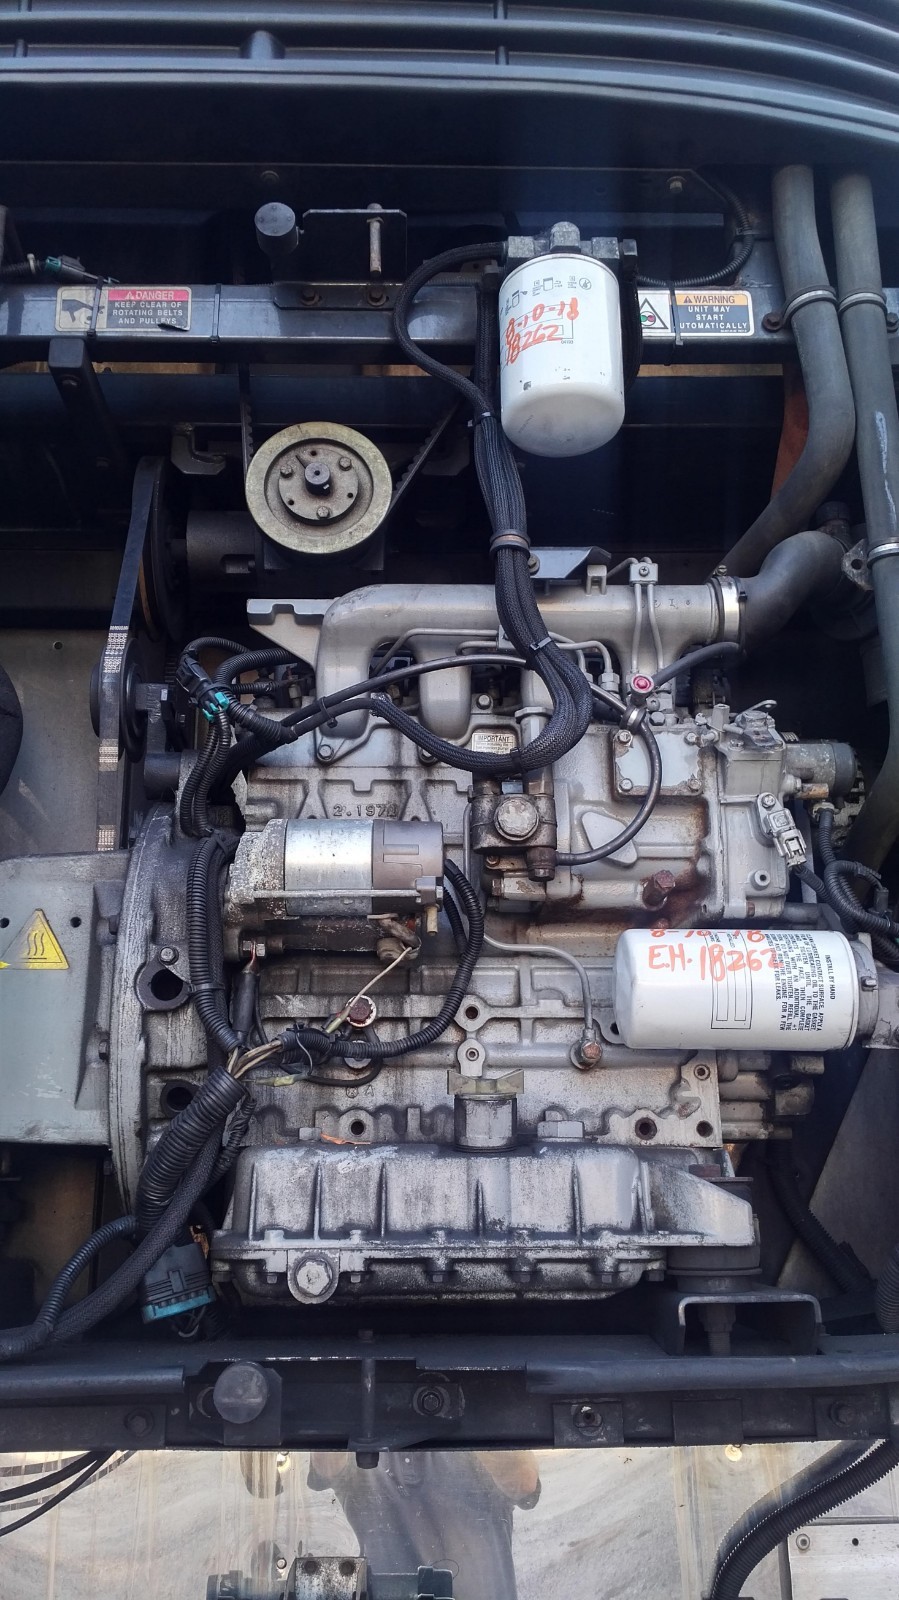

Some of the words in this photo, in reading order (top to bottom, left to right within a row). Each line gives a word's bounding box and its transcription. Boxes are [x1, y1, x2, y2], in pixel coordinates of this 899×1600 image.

[136, 291, 174, 300] DANGER
[694, 295, 735, 304] WARNING
[478, 734, 510, 742] IMPORTANT
[700, 944, 783, 982] 18262
[800, 947, 808, 964] TIGHTEN
[815, 960, 823, 983] CONTACT
[825, 955, 833, 974] INSTALL
[810, 1013, 818, 1031] GASKET.
